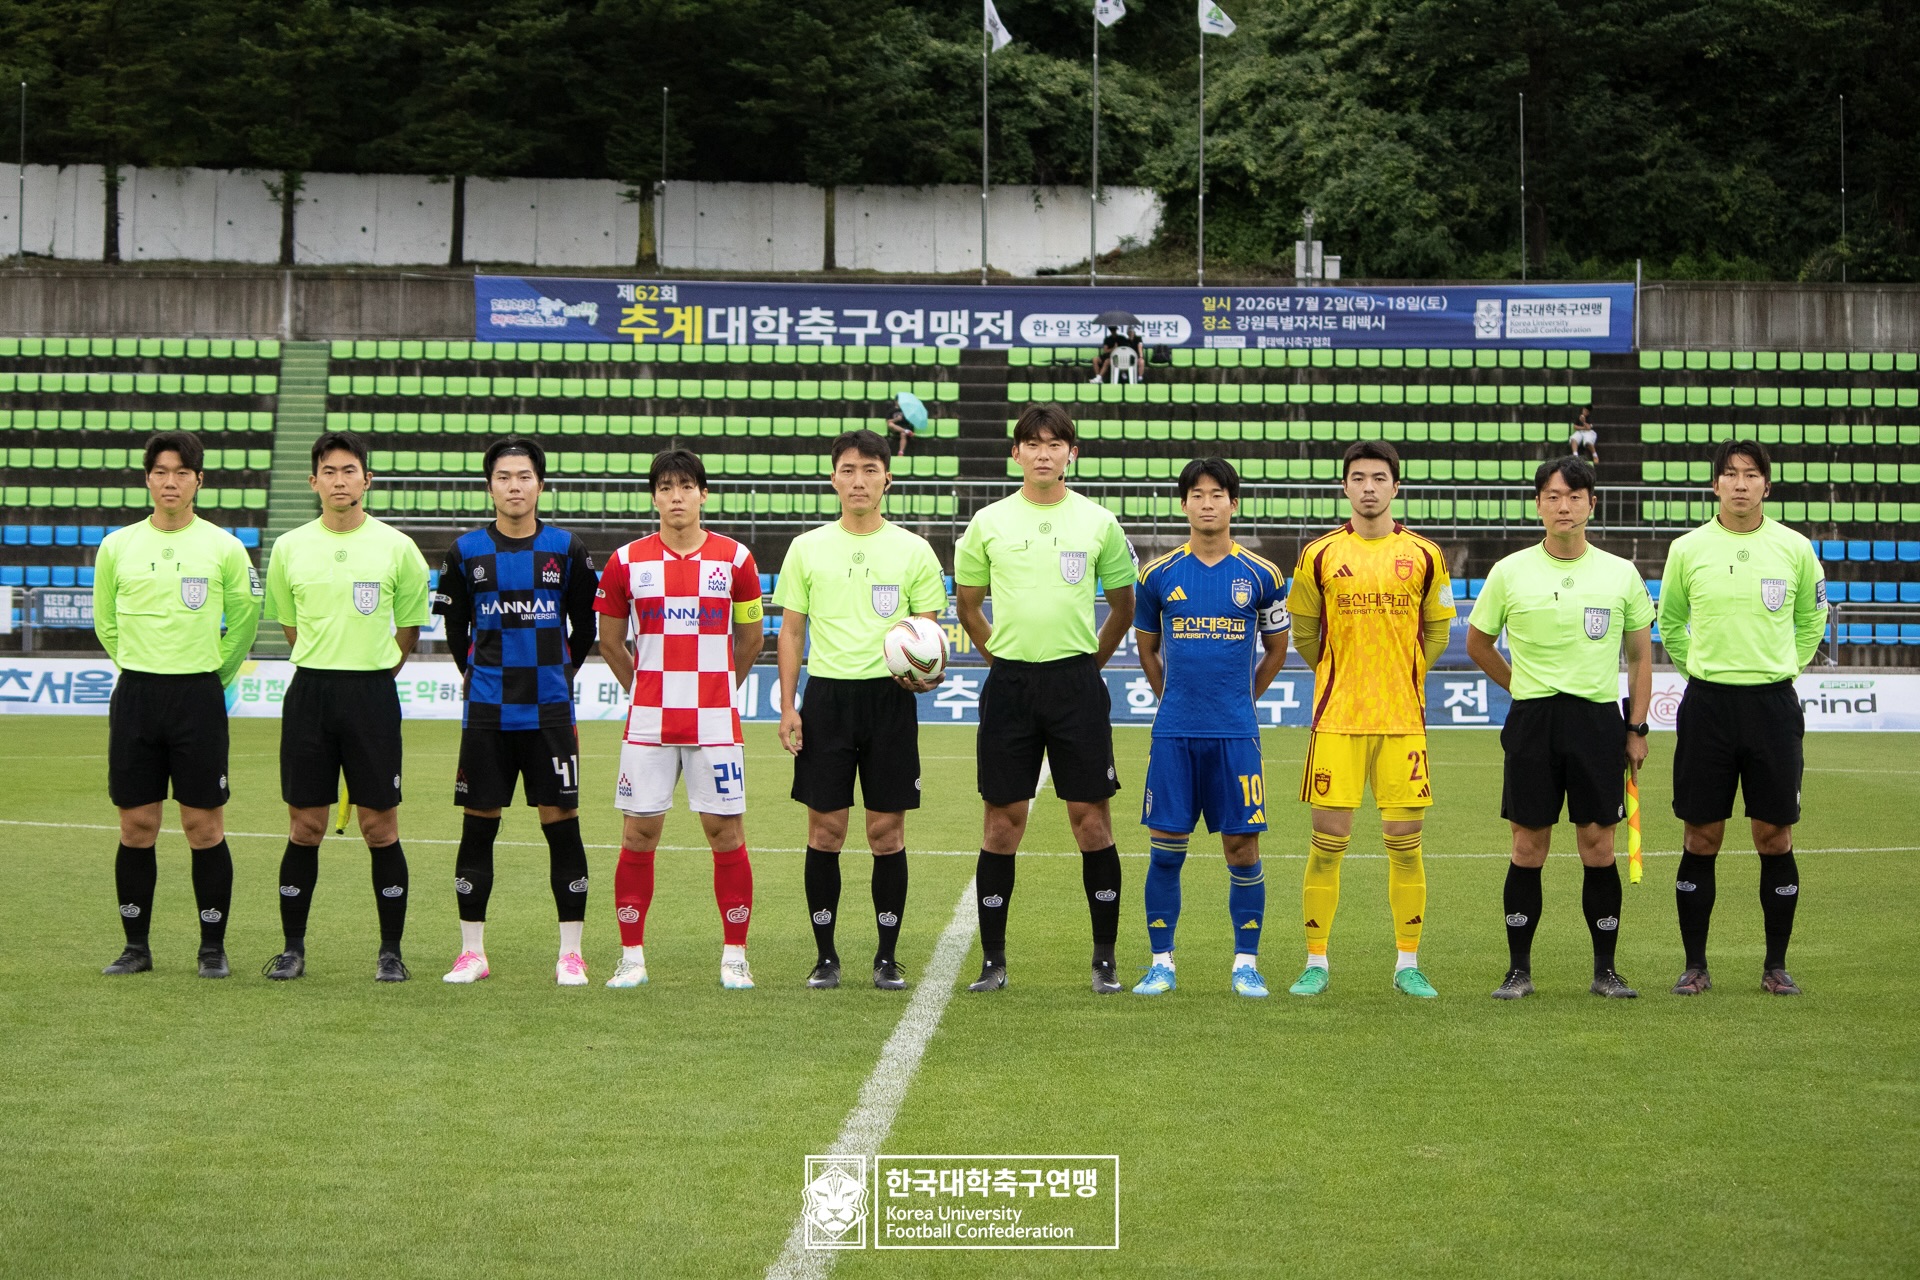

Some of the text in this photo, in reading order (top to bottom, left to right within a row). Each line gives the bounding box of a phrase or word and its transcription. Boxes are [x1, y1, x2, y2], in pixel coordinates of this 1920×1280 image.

[617, 285, 678, 302] 제62회
[1202, 296, 1231, 312] 일시
[1235, 296, 1291, 312] 2026년
[1294, 296, 1319, 312] 7월
[1510, 302, 1603, 317] 한국대학축구연맹
[1202, 315, 1386, 331] 장소 강원특별자치도 태백시
[1509, 318, 1569, 328] Korea University
[1509, 325, 1592, 335] Football Confederation
[543, 570, 560, 578] HAN
[709, 579, 727, 587] HAN
[43, 593, 72, 606] KEEP
[1337, 592, 1410, 608] 울산대학교
[43, 606, 80, 619] NEVER
[641, 604, 724, 620] HANNAM
[1338, 608, 1378, 616] UNIVERSITY
[1172, 617, 1246, 633] 울산대학교
[1172, 632, 1211, 640] UNIVERSITY
[1222, 633, 1245, 641] ULSAN
[1822, 681, 1873, 689] SPORTS
[552, 754, 578, 788] 41
[1407, 750, 1429, 781] 21
[713, 762, 743, 794] 24
[1238, 774, 1263, 807] 10
